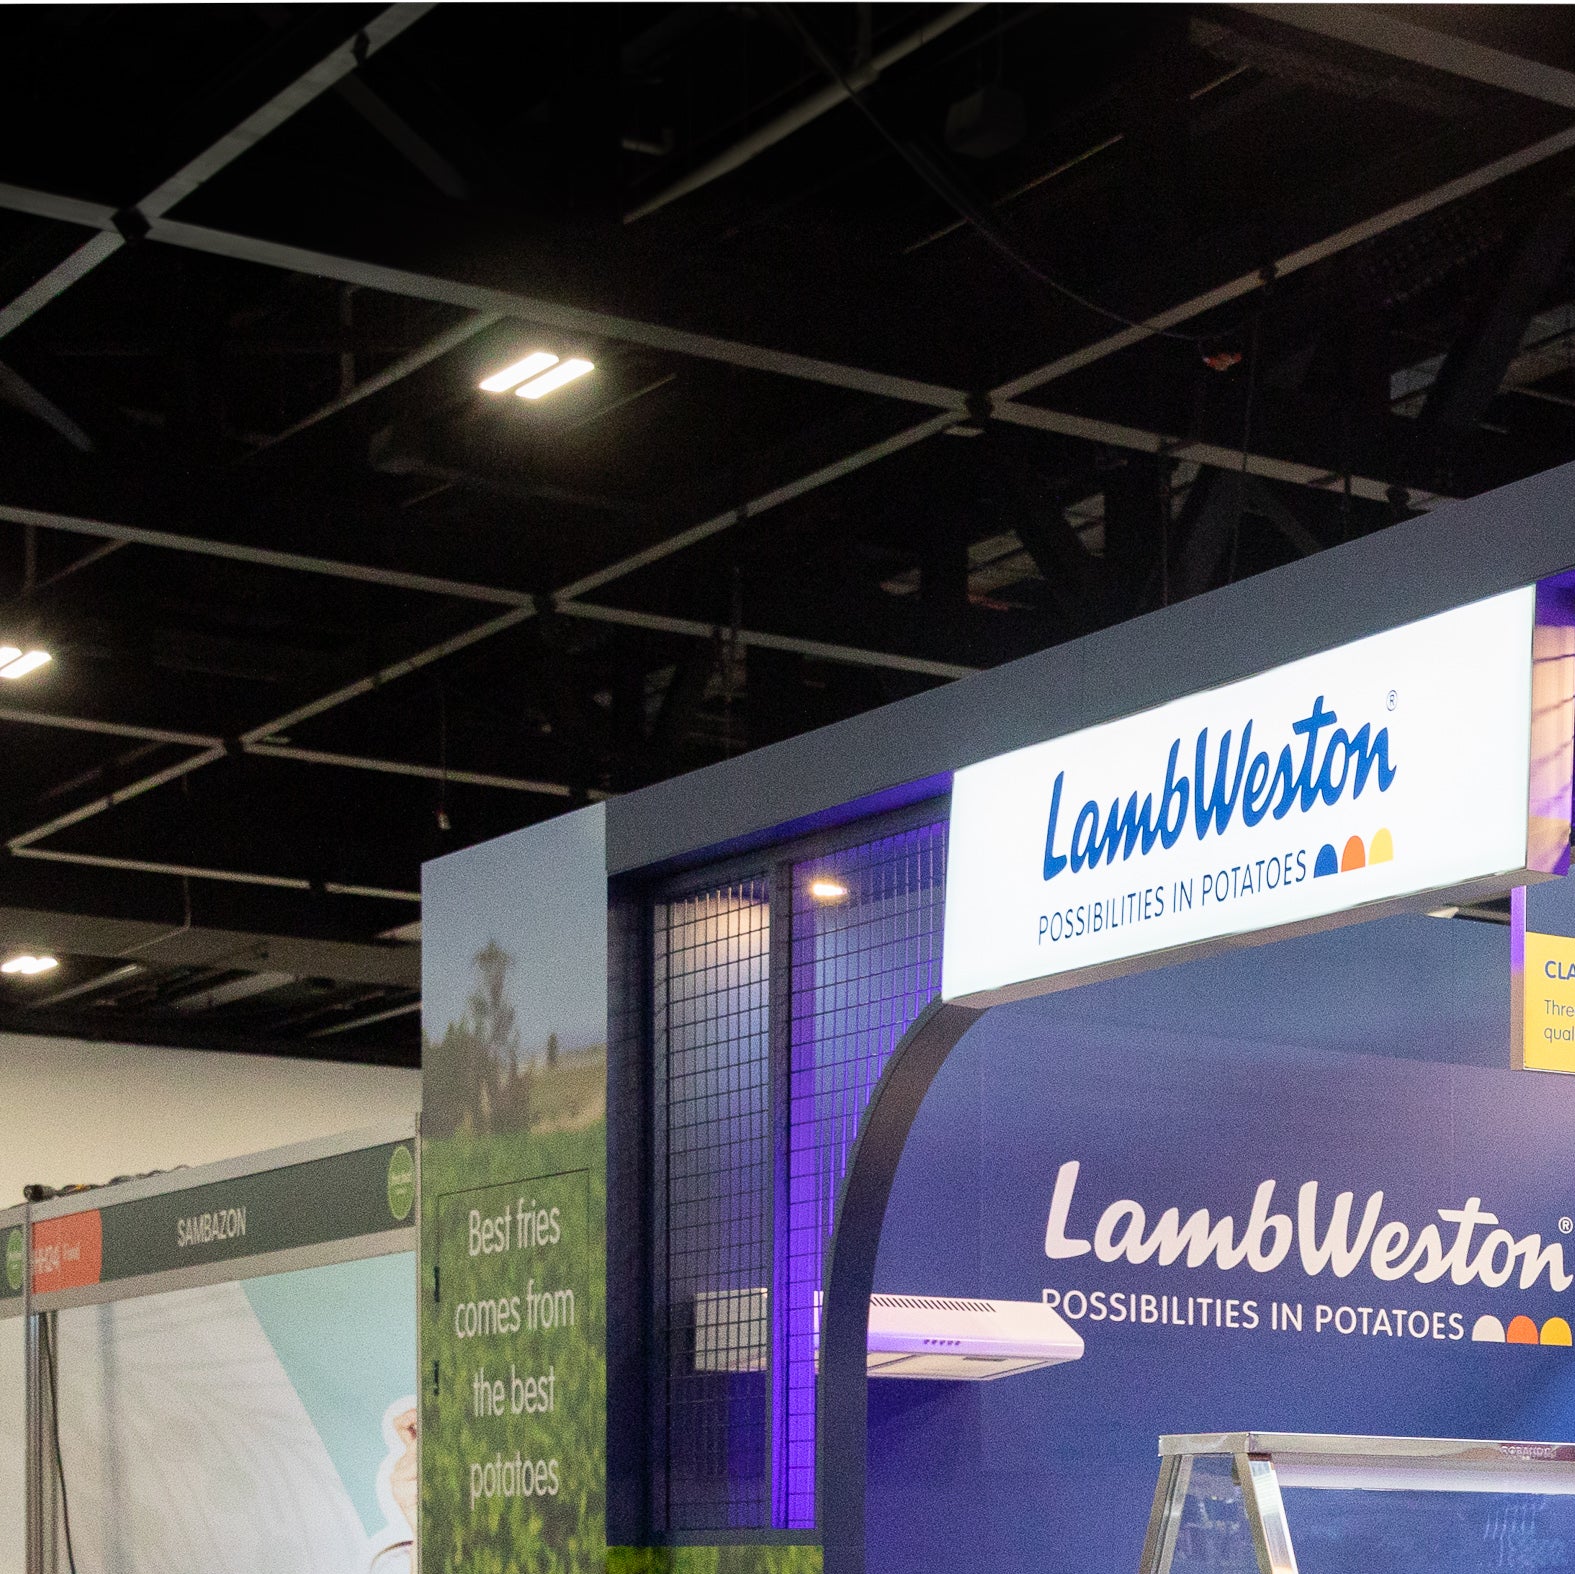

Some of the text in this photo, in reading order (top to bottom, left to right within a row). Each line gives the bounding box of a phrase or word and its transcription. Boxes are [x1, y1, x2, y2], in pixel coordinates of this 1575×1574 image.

[1042, 695, 1397, 882] LambWeston
[1038, 848, 1308, 946] POSSIBILITIES IN POTATOES
[176, 1208, 246, 1247] SAMBAZON
[469, 1197, 560, 1256] Best fries
[1042, 1160, 1574, 1293] LambWeston
[455, 1279, 574, 1339] comes from
[1041, 1288, 1466, 1342] POSSIBILITIES IN POTATOES
[474, 1363, 555, 1417] the best
[470, 1452, 558, 1511] potatoes
